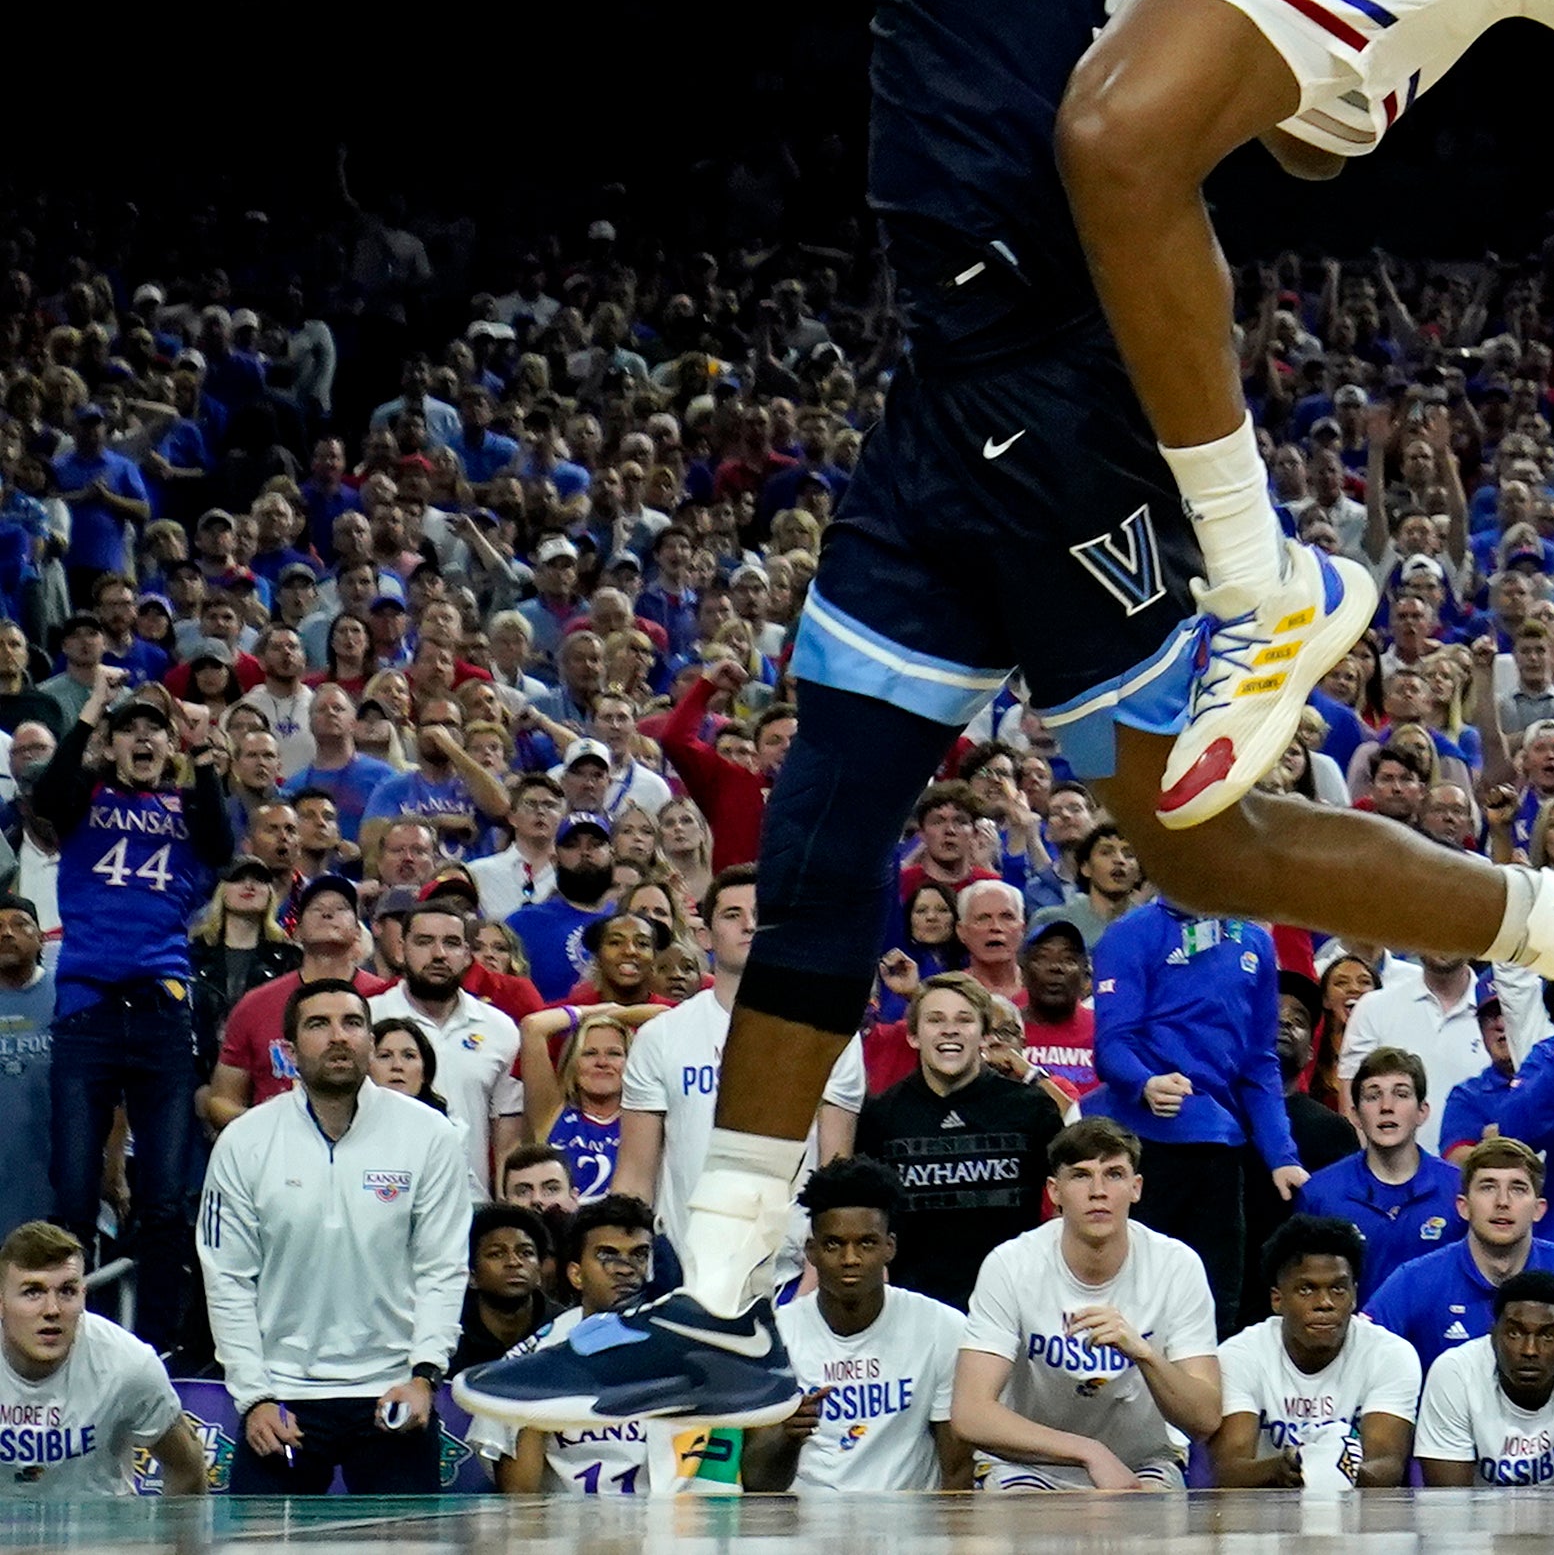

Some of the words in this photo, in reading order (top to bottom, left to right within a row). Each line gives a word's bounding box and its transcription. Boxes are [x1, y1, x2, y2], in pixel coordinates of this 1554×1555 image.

[1069, 503, 1168, 617] V
[89, 806, 190, 840] KANSAS
[91, 836, 174, 892] 44
[366, 1174, 412, 1185] KANSAS
[576, 1153, 612, 1205] 2
[823, 1360, 862, 1382] MORE
[866, 1357, 881, 1377] IS
[1, 1406, 43, 1426] MORE
[47, 1406, 61, 1426] IS
[1320, 1395, 1334, 1416] IS
[573, 1462, 641, 1494] 11
